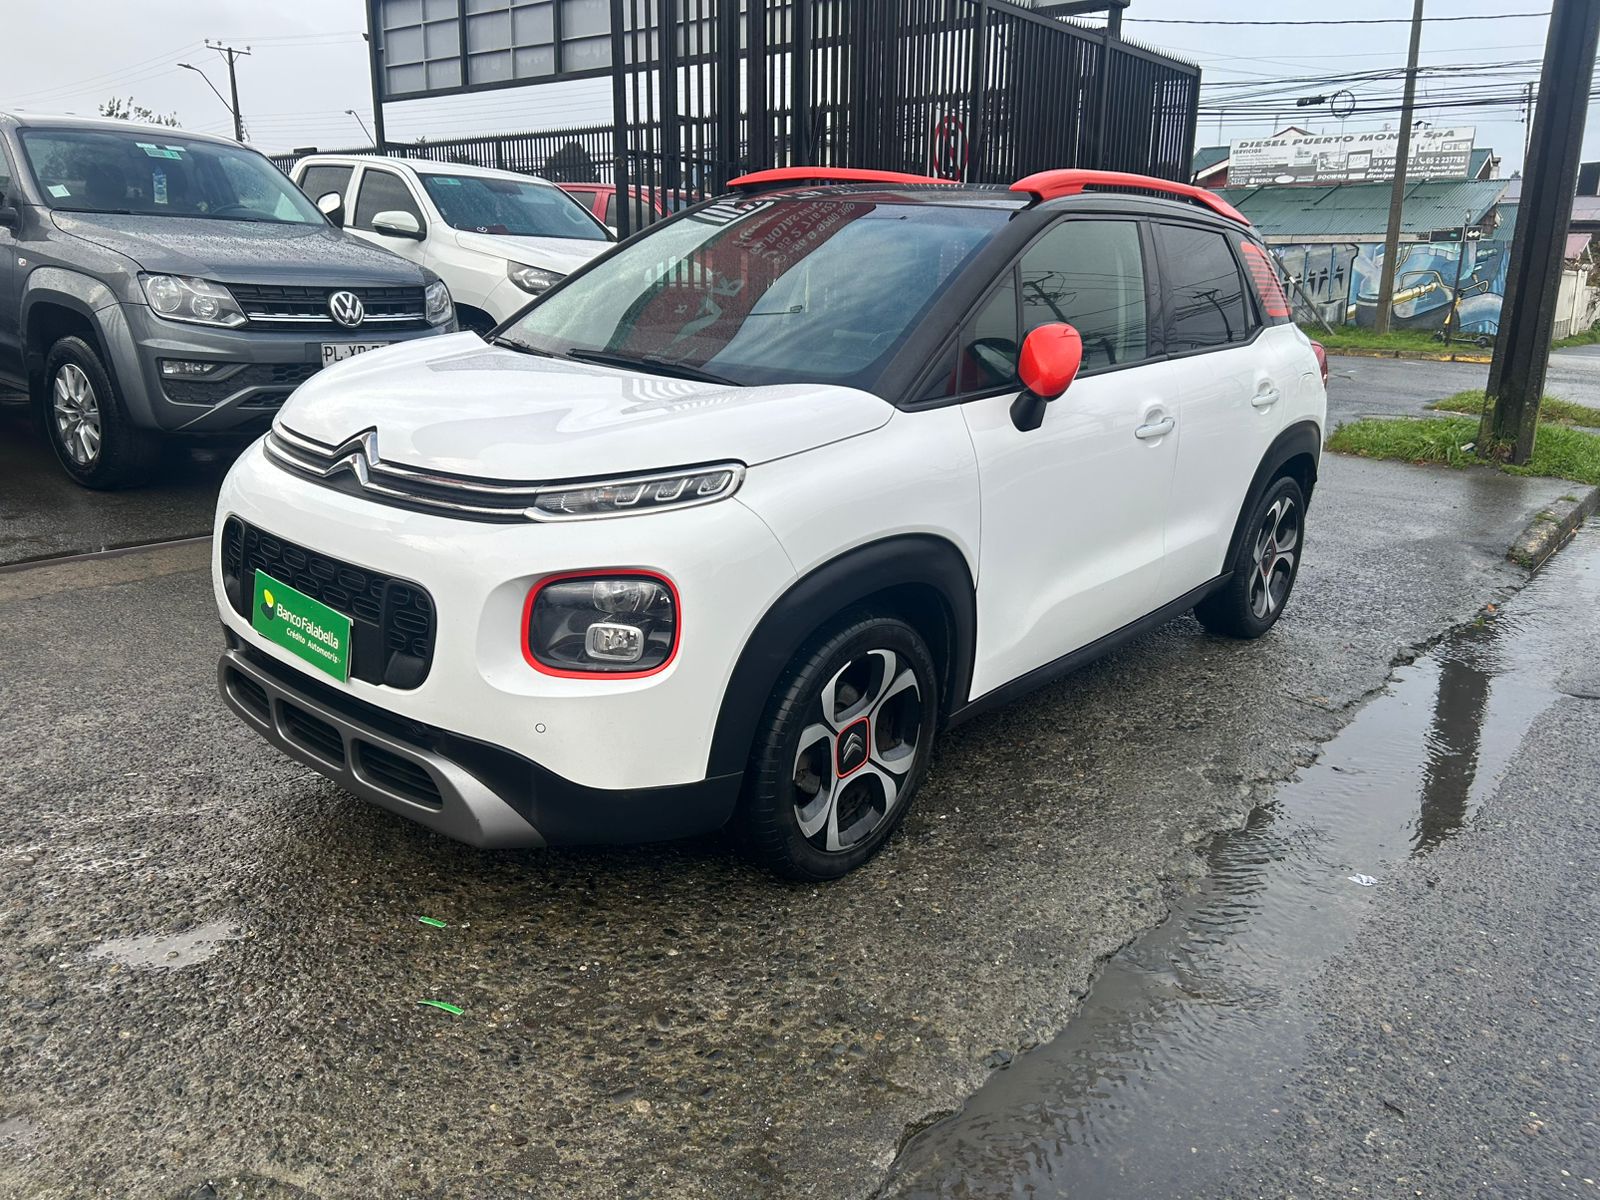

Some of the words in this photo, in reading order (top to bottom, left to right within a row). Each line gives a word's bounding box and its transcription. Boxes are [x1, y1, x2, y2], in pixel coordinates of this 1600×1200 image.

[1238, 139, 1288, 149] DIESEL
[1292, 135, 1355, 146] PUERTO
[1359, 131, 1420, 142] MONT
[1423, 130, 1455, 140] SpA
[286, 627, 306, 645] Crédito
[307, 639, 339, 664] Automotriz
